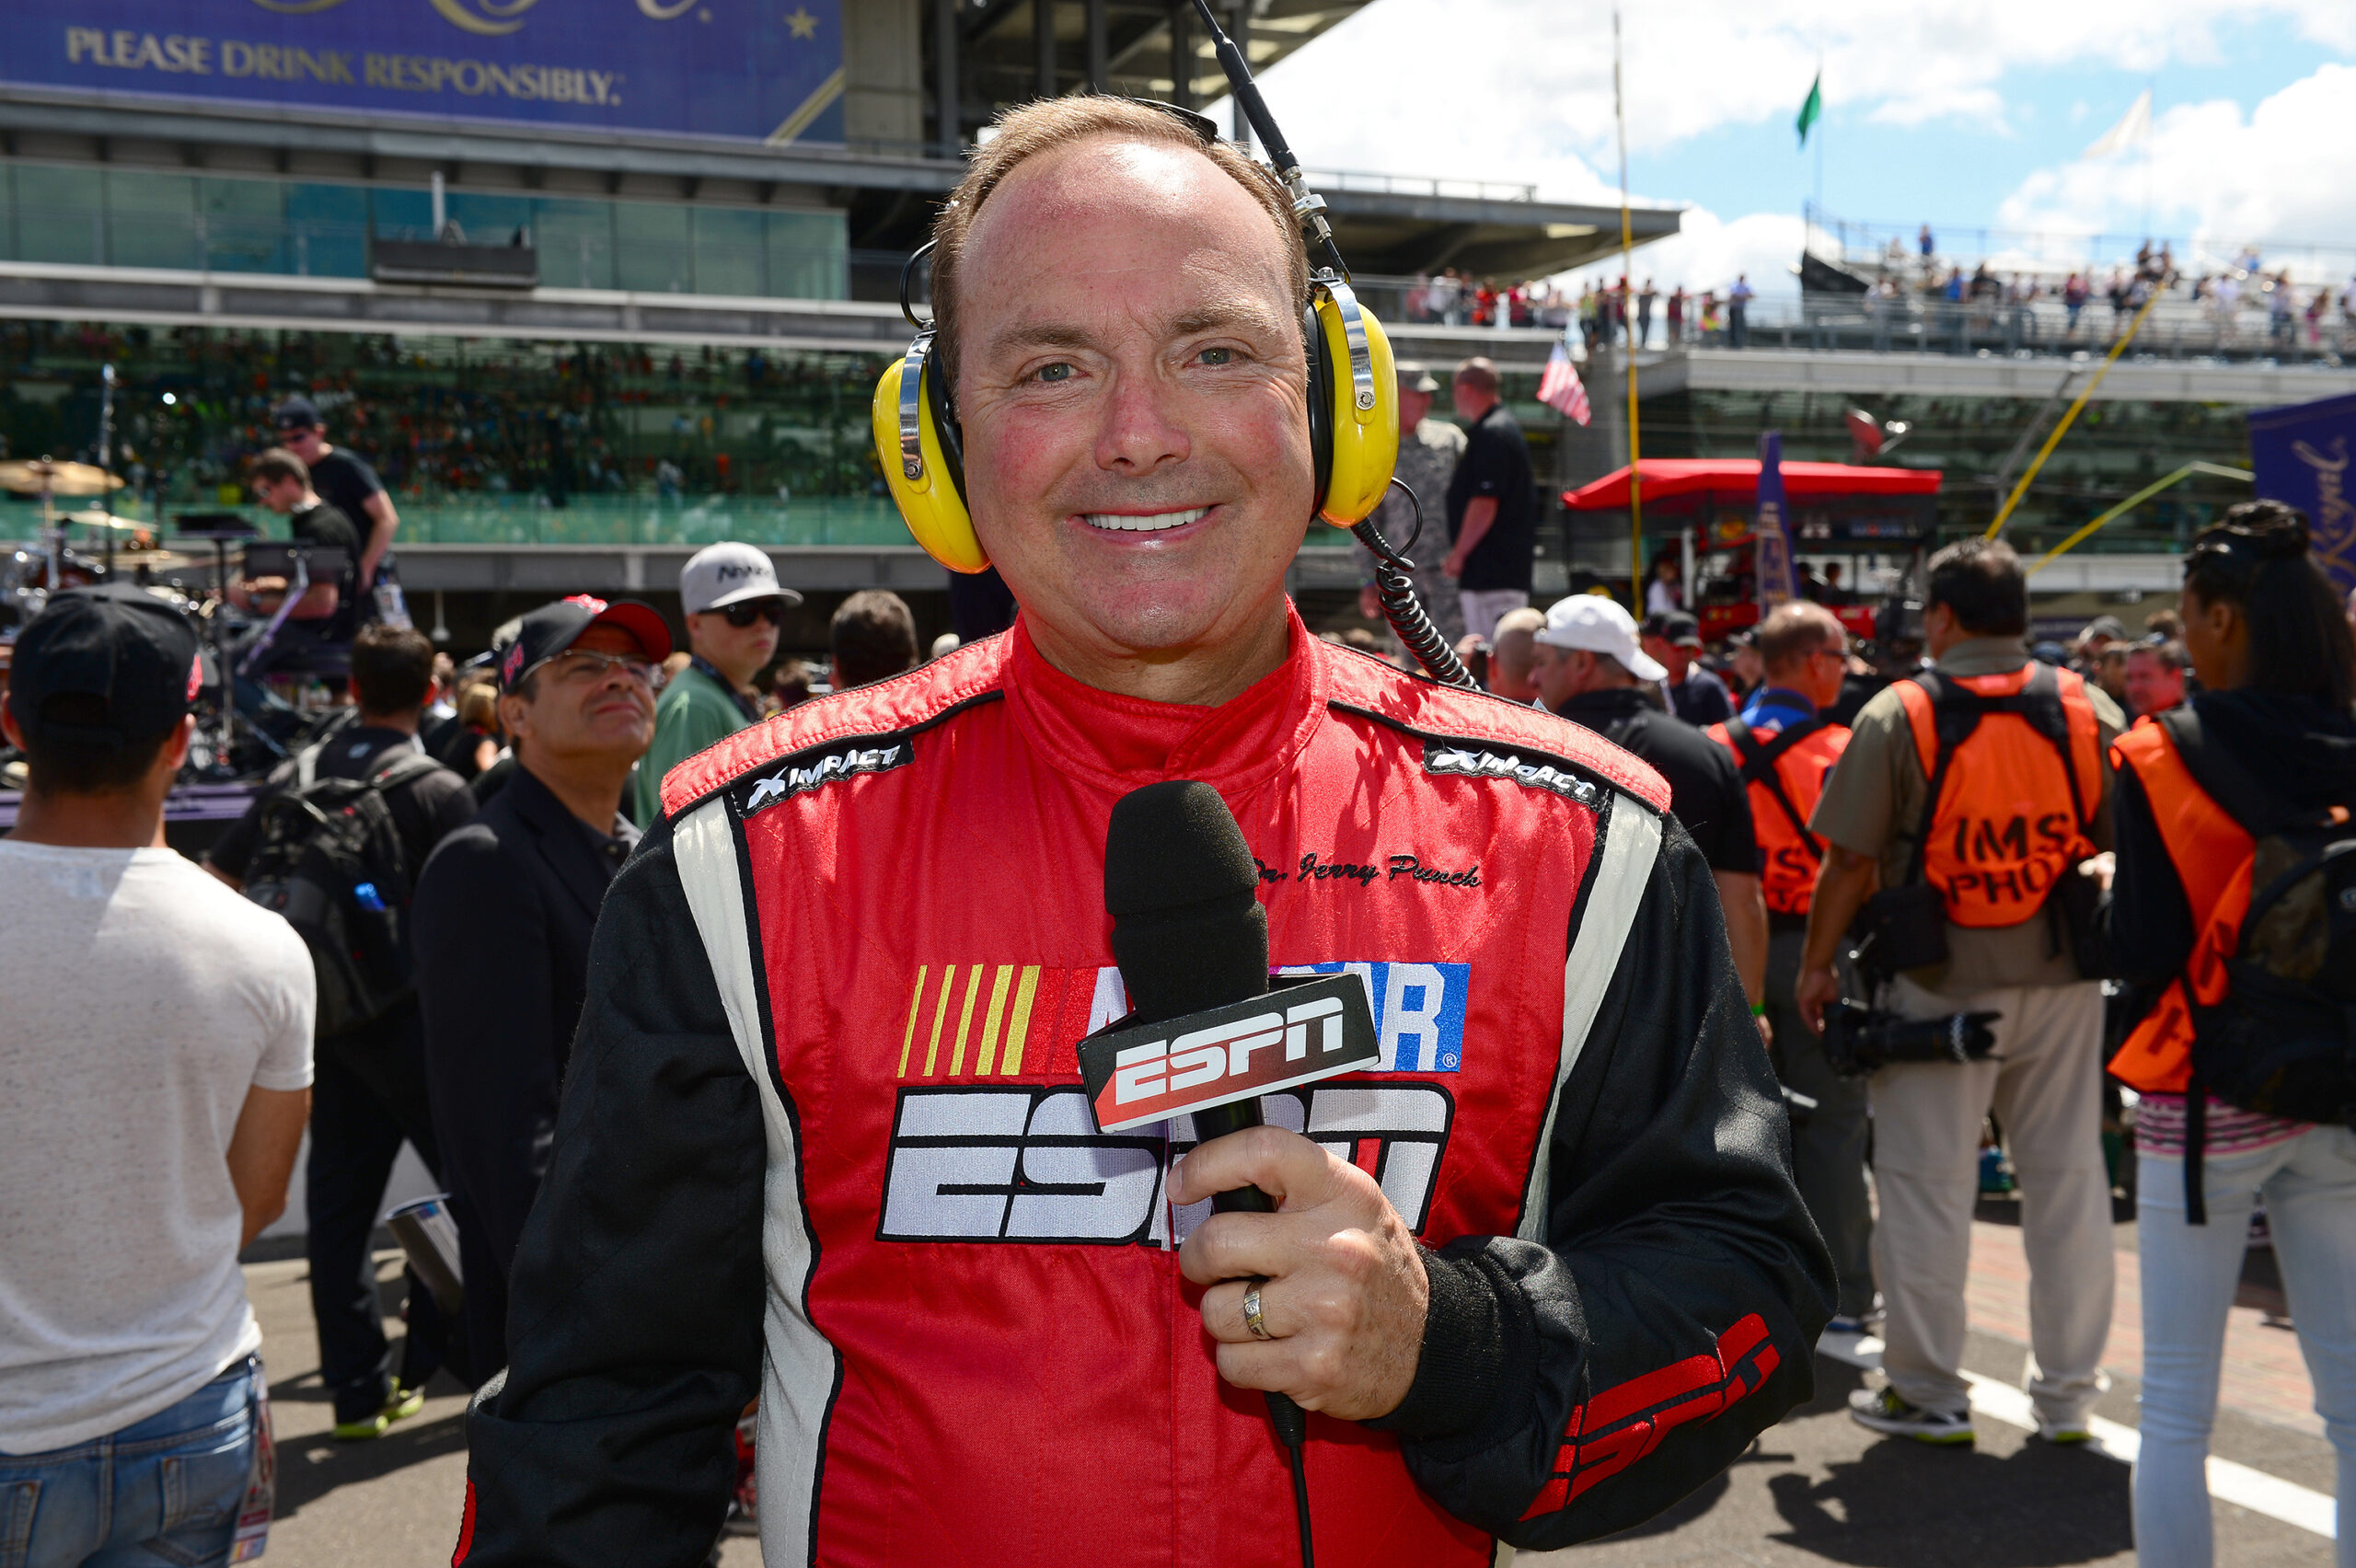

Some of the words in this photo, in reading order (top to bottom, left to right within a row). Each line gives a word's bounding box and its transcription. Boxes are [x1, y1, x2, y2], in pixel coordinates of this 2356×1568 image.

[65, 26, 213, 75] PLEASE
[220, 39, 356, 86] DRINK
[1954, 813, 2069, 863] IMS
[1298, 852, 1380, 886] Jerry
[1389, 854, 1483, 888] Punch
[1114, 997, 1345, 1106] ESPN
